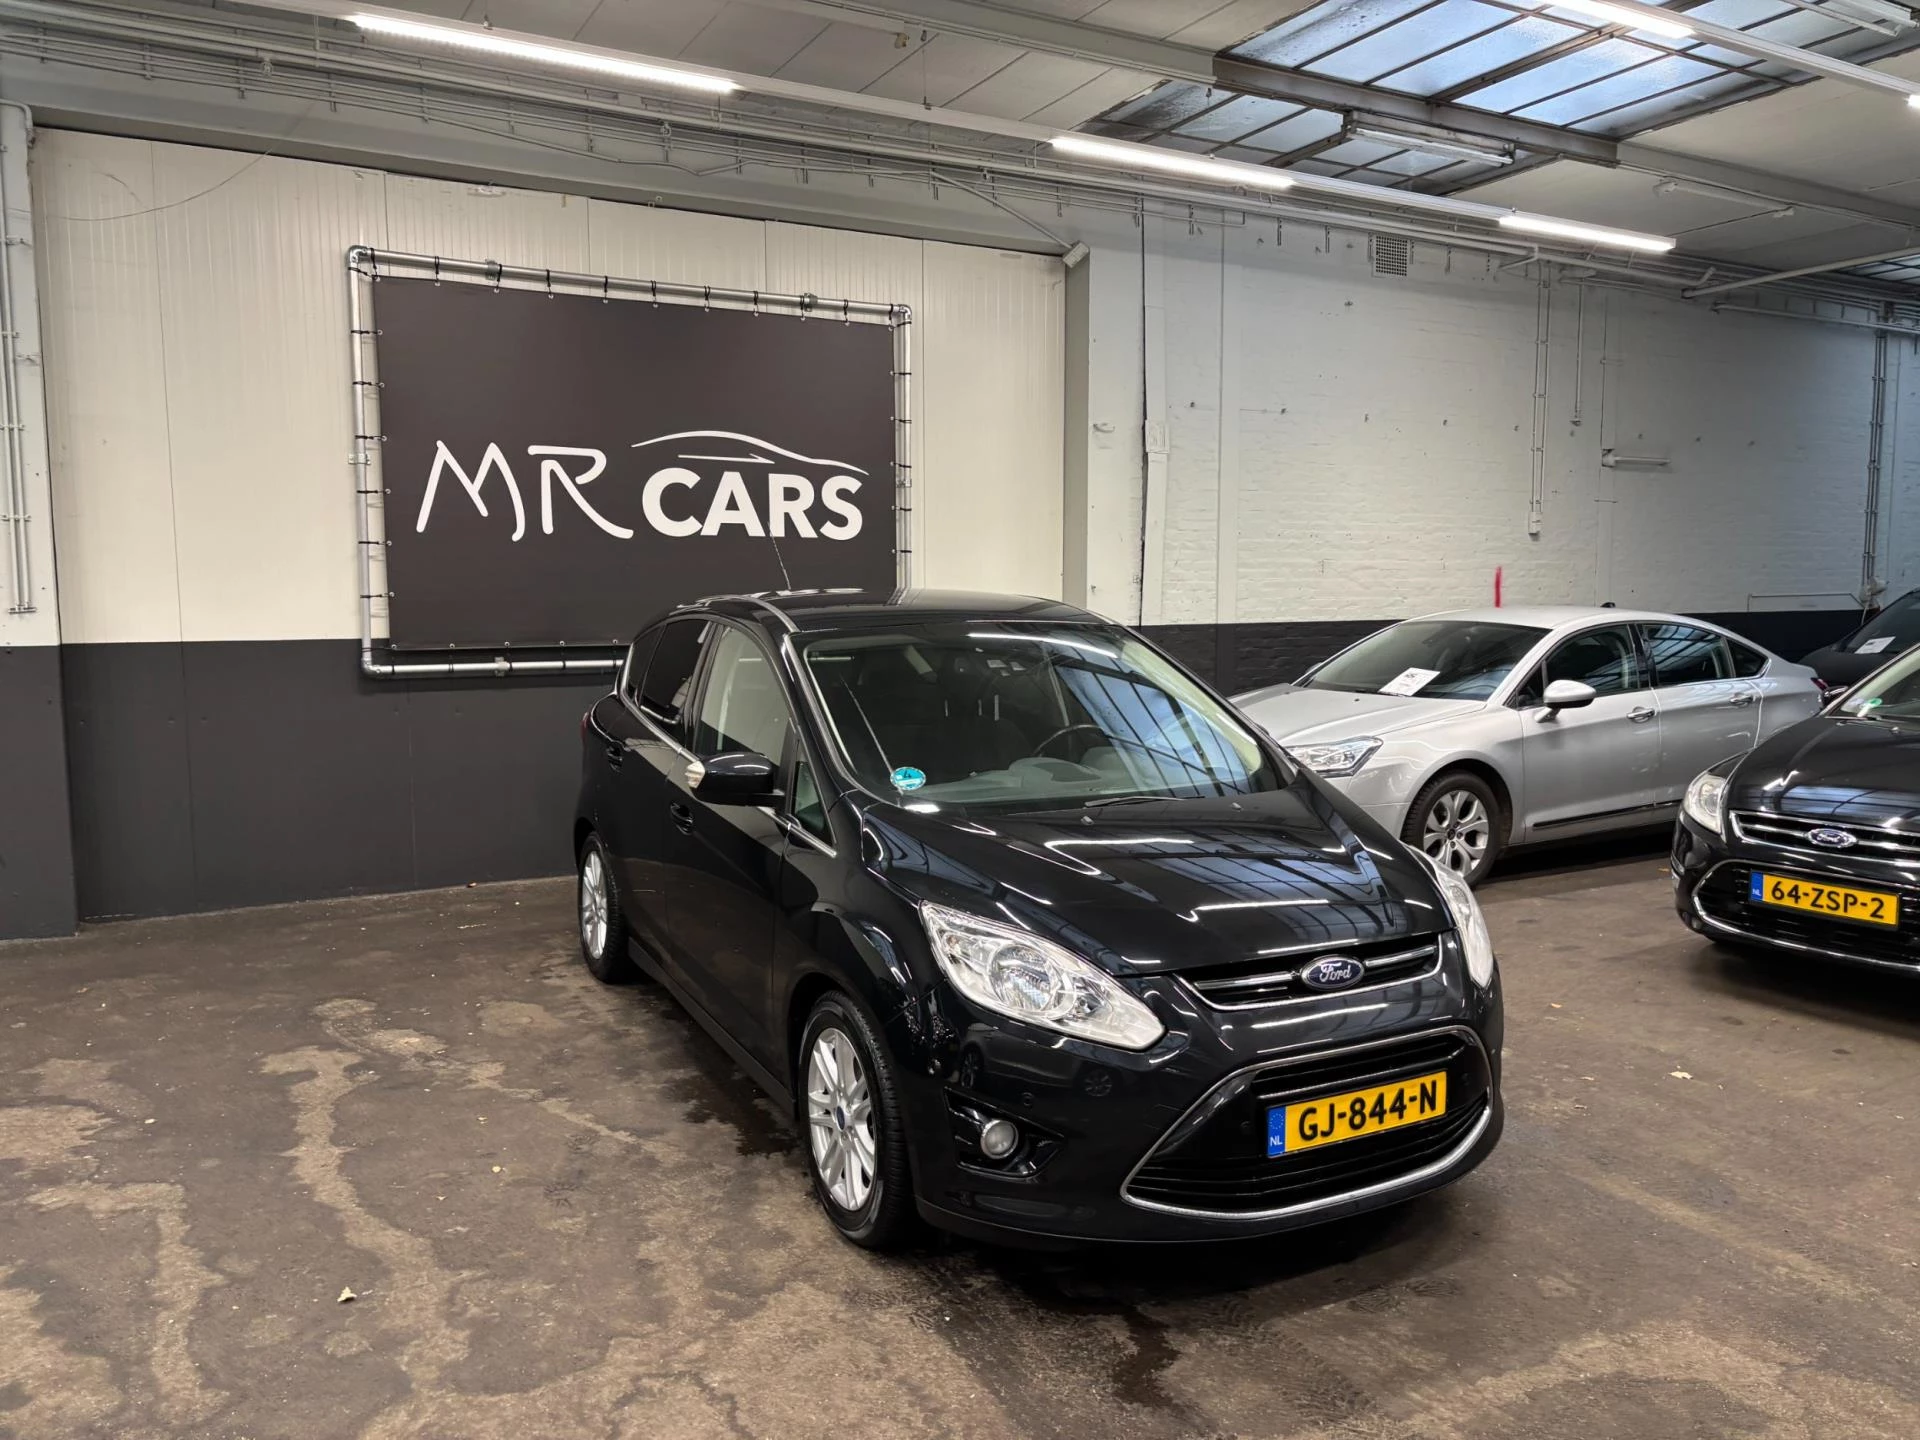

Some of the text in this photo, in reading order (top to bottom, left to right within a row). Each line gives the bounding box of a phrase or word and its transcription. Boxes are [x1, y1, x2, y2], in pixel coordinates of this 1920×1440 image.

[416, 439, 864, 542] MR CARS
[1752, 888, 1762, 897] NL
[1770, 881, 1885, 919] 64-ZSP-2
[1319, 962, 1352, 982] Ford
[1299, 1080, 1437, 1141] GJ-844-N
[1269, 1135, 1283, 1146] NL
